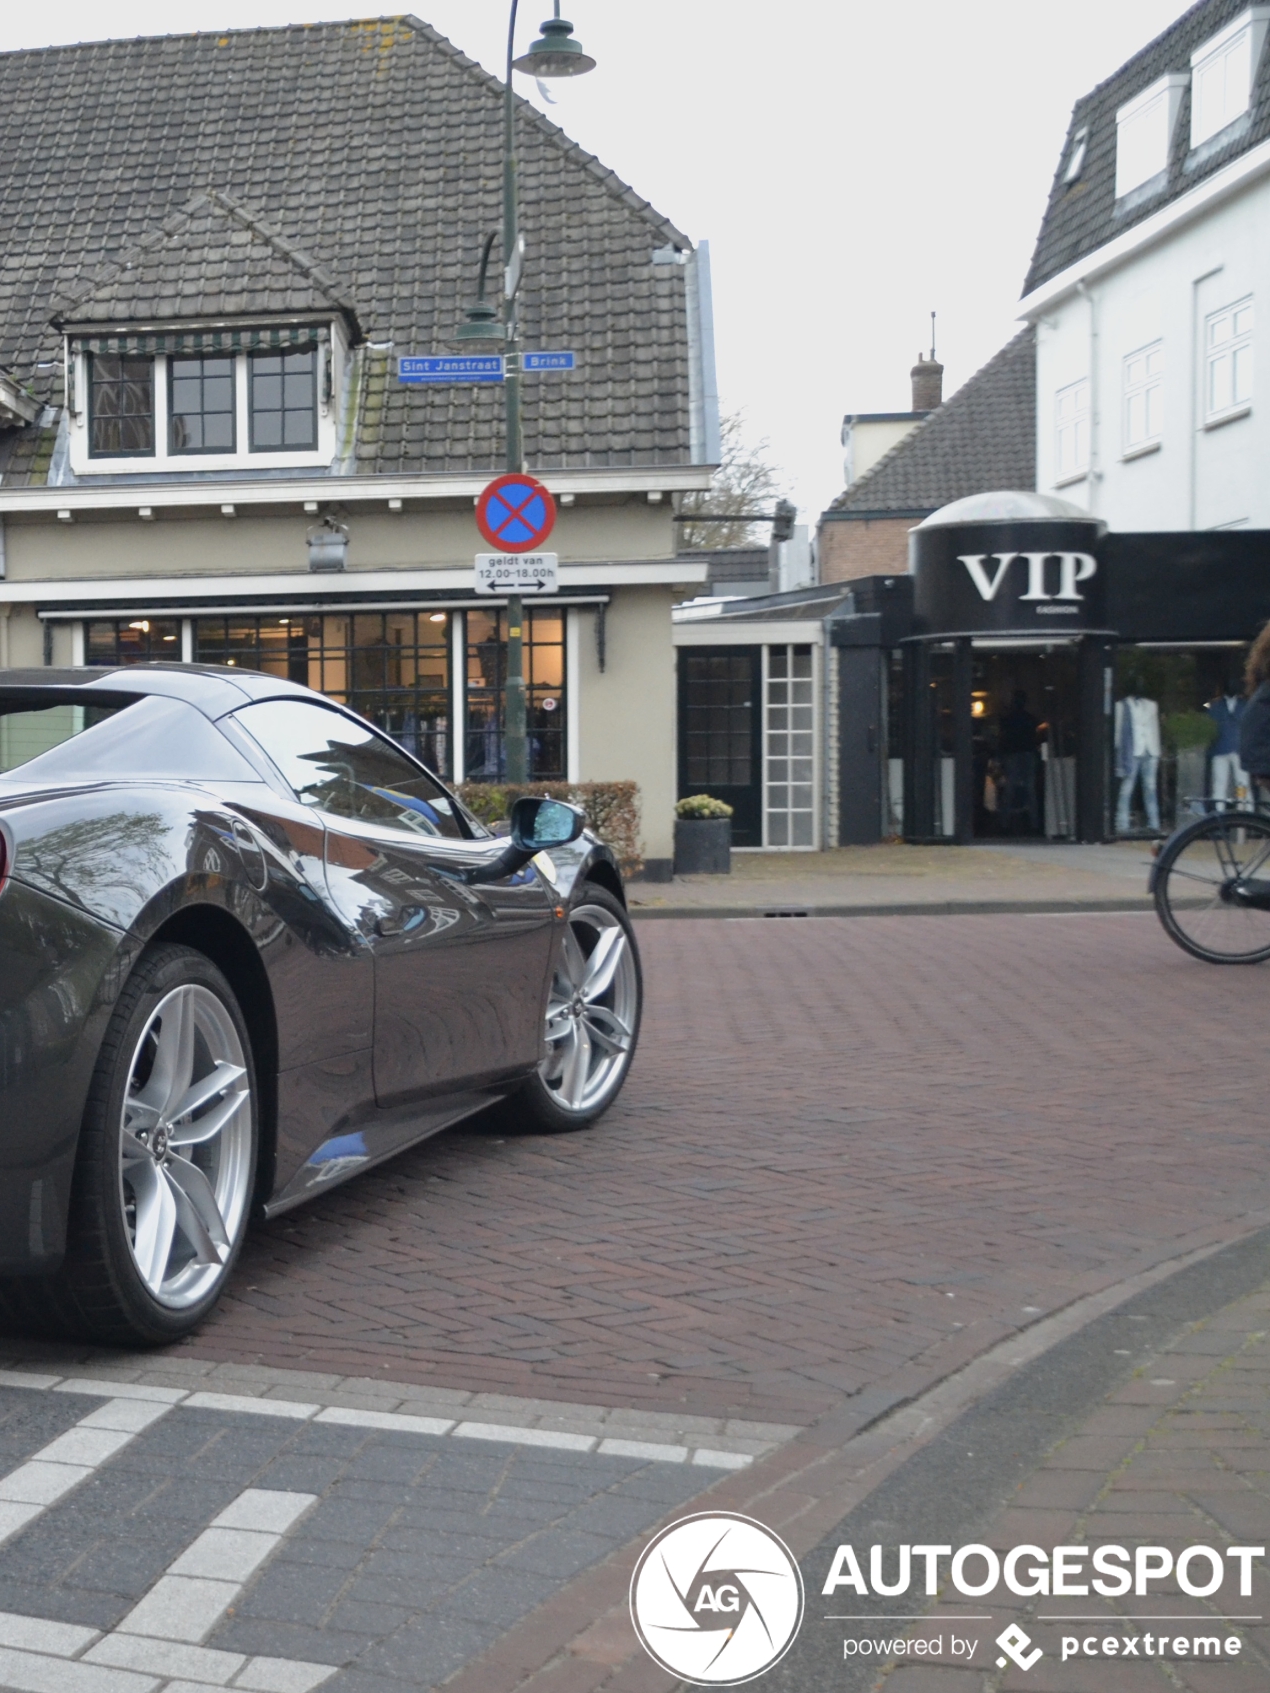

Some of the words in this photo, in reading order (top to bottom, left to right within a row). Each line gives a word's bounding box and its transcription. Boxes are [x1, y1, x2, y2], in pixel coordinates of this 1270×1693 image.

[403, 361, 429, 371] Sint
[435, 360, 498, 371] Janstraat
[530, 356, 567, 367] Brink
[488, 556, 519, 567] geldt
[522, 556, 544, 565] van
[479, 568, 554, 579] 12.00-18.00h
[956, 551, 1098, 602] VIP
[1035, 605, 1079, 614] FASHION
